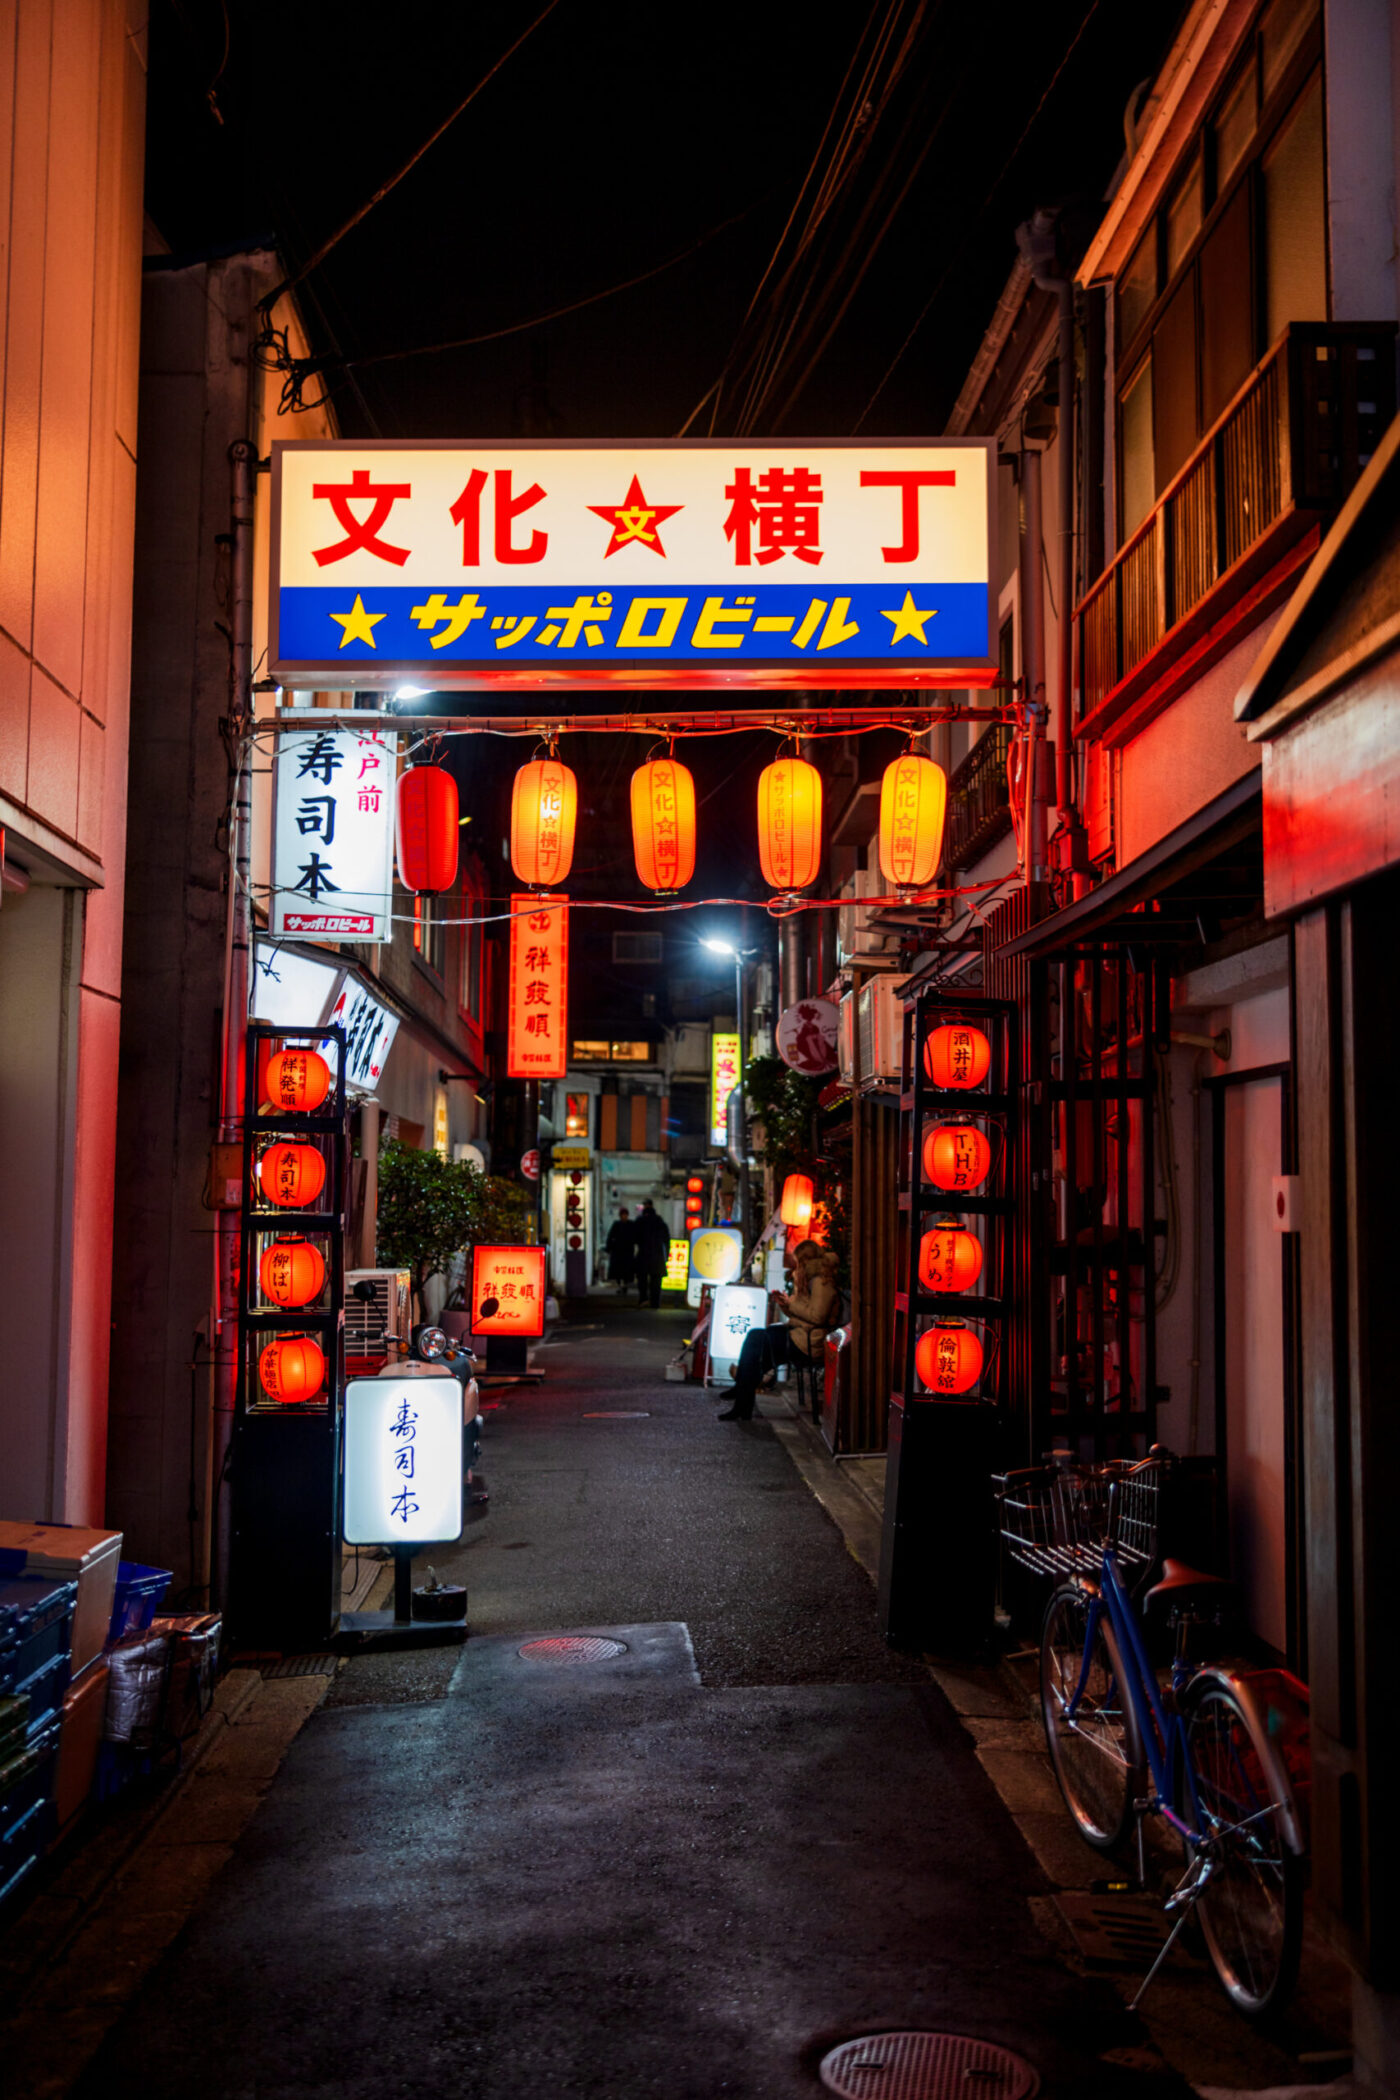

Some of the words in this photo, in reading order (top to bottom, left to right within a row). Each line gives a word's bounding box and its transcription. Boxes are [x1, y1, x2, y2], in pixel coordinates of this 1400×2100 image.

[311, 468, 548, 567] 文化
[724, 467, 957, 566] 横丁
[409, 592, 860, 651] サッポロビール
[295, 733, 345, 904] 寿司本
[287, 916, 372, 933] サッポロビール
[953, 1031, 972, 1084] 酒井屋
[278, 1151, 297, 1201] 寿司本
[271, 1252, 290, 1304] 柳ばし
[927, 1243, 943, 1283] うめ
[388, 1398, 421, 1524] 寿司本
